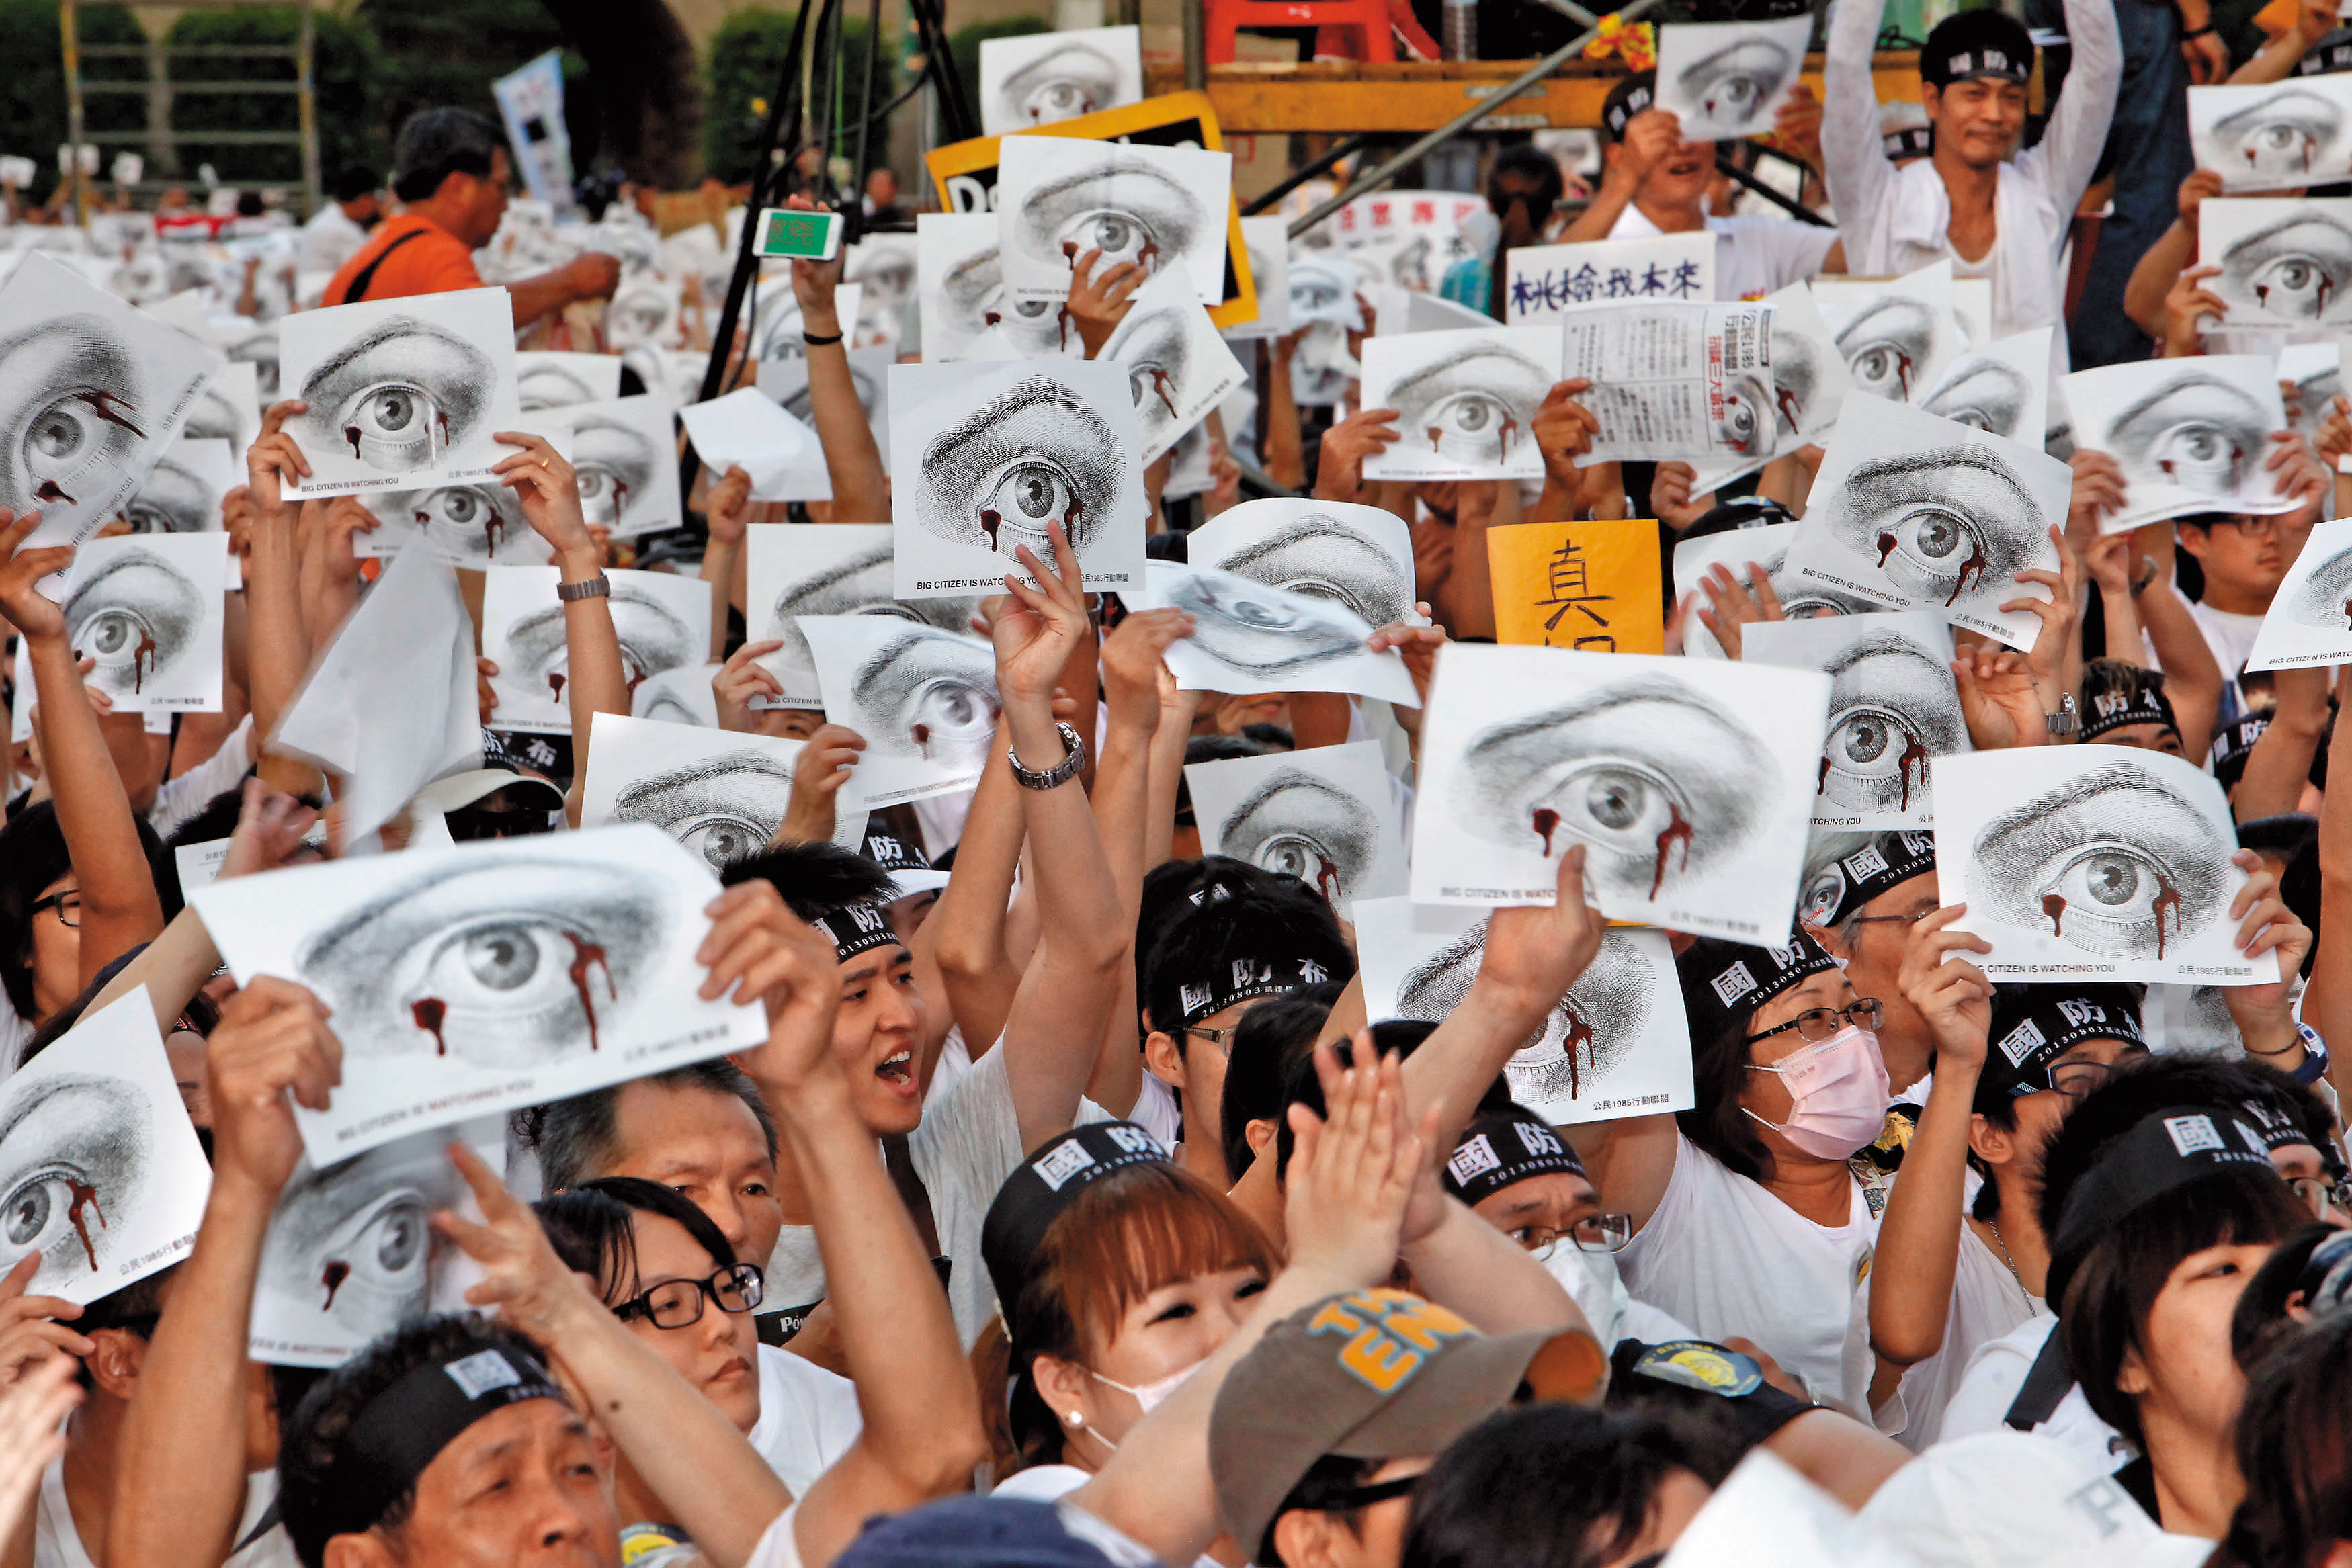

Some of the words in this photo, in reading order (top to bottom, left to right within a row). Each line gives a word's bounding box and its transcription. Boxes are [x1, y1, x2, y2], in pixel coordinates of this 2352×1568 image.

[119, 476, 134, 494] YOU
[302, 484, 314, 492] BIG
[317, 482, 343, 492] CITIZEN
[351, 479, 384, 488] WATCHING
[385, 477, 399, 486] YOU
[917, 581, 932, 590] BIG
[934, 579, 968, 589] CITIZEN
[970, 579, 978, 587] IS
[1802, 568, 1816, 578] BIG
[1817, 572, 1847, 586] CITIZEN
[1847, 581, 1855, 591] IS
[1855, 584, 1894, 603] WATCHING
[1895, 596, 1911, 607] YOU
[2286, 654, 2318, 663] CITIZEN
[782, 697, 812, 705] CITIZEN
[1846, 817, 1861, 825] YOU
[1441, 886, 1462, 898] BIG
[1465, 887, 1511, 900] CITIZEN
[1512, 888, 1523, 900] IS
[1524, 889, 1558, 900] WATC
[839, 932, 887, 956] 0130803
[1987, 963, 2027, 974] CITIZEN
[2028, 964, 2039, 974] IS
[2040, 963, 2094, 974] WATCHING
[2095, 963, 2115, 973] YOU
[2035, 1025, 2104, 1063] 20130803
[1593, 1093, 1669, 1111] 公民1985行動聯盟
[1447, 1121, 1563, 1188] 國防
[119, 1231, 200, 1276] 公民1985行動聯
